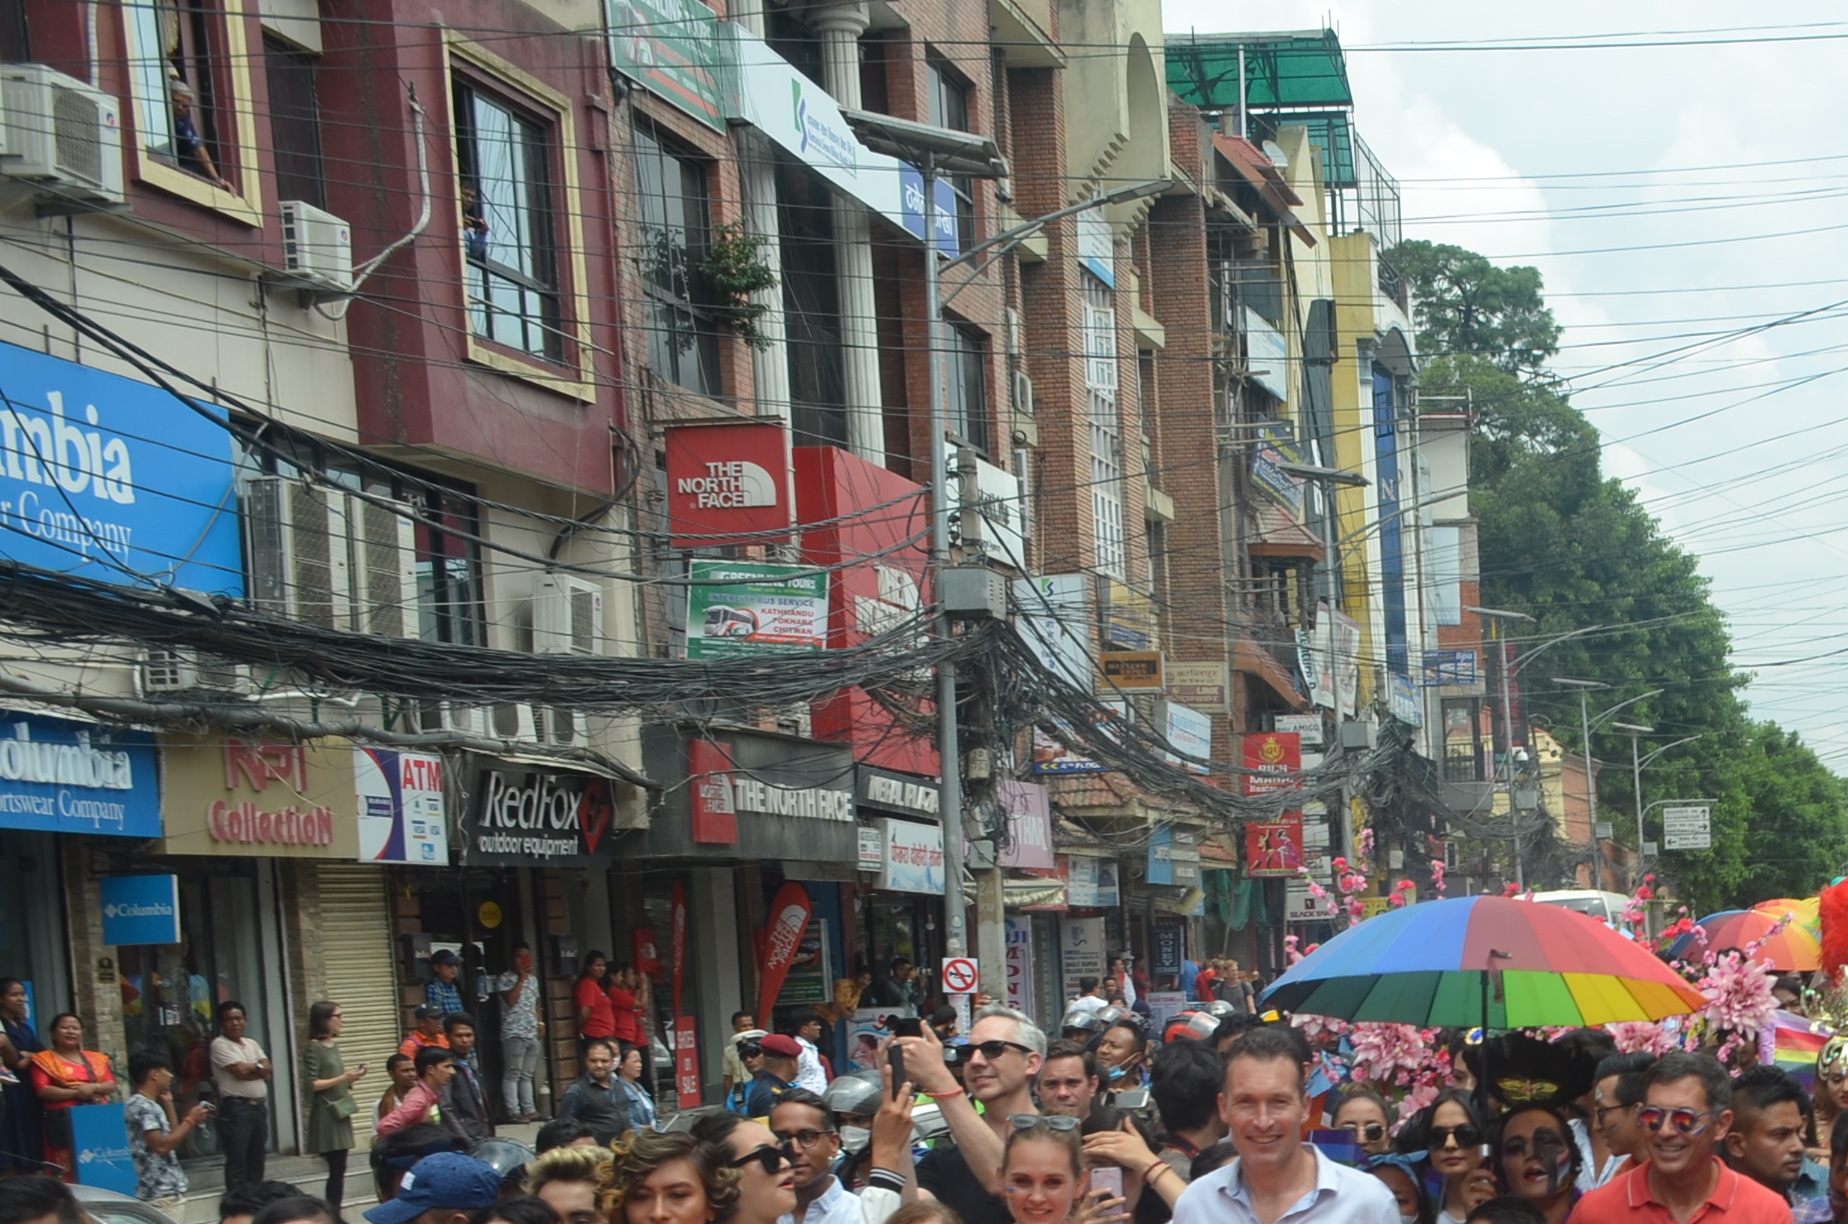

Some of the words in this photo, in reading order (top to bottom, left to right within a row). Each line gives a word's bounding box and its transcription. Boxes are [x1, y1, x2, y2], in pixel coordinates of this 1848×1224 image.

[0, 391, 135, 504] mbia
[678, 478, 743, 494] NORTH
[706, 462, 742, 477] THE
[698, 493, 745, 509] FACE
[19, 490, 132, 566] Company
[758, 596, 775, 605] BUS
[778, 597, 815, 608] SERVICE
[761, 608, 814, 617] KATHMANDU
[0, 721, 133, 789] olumbia
[403, 759, 443, 792] ATM
[58, 790, 125, 831] Company
[480, 771, 584, 830] RedFox
[735, 779, 766, 813] THE
[766, 784, 816, 818] NORTH
[818, 789, 854, 822] FACE
[479, 832, 523, 854] outdoor
[524, 834, 579, 860] equipment
[118, 902, 173, 917] Columbia
[771, 919, 786, 943] THE
[1003, 930, 1028, 944] UJI
[767, 926, 792, 970] NORTH
[780, 932, 797, 967] FACE
[1005, 946, 1022, 1011] MONE
